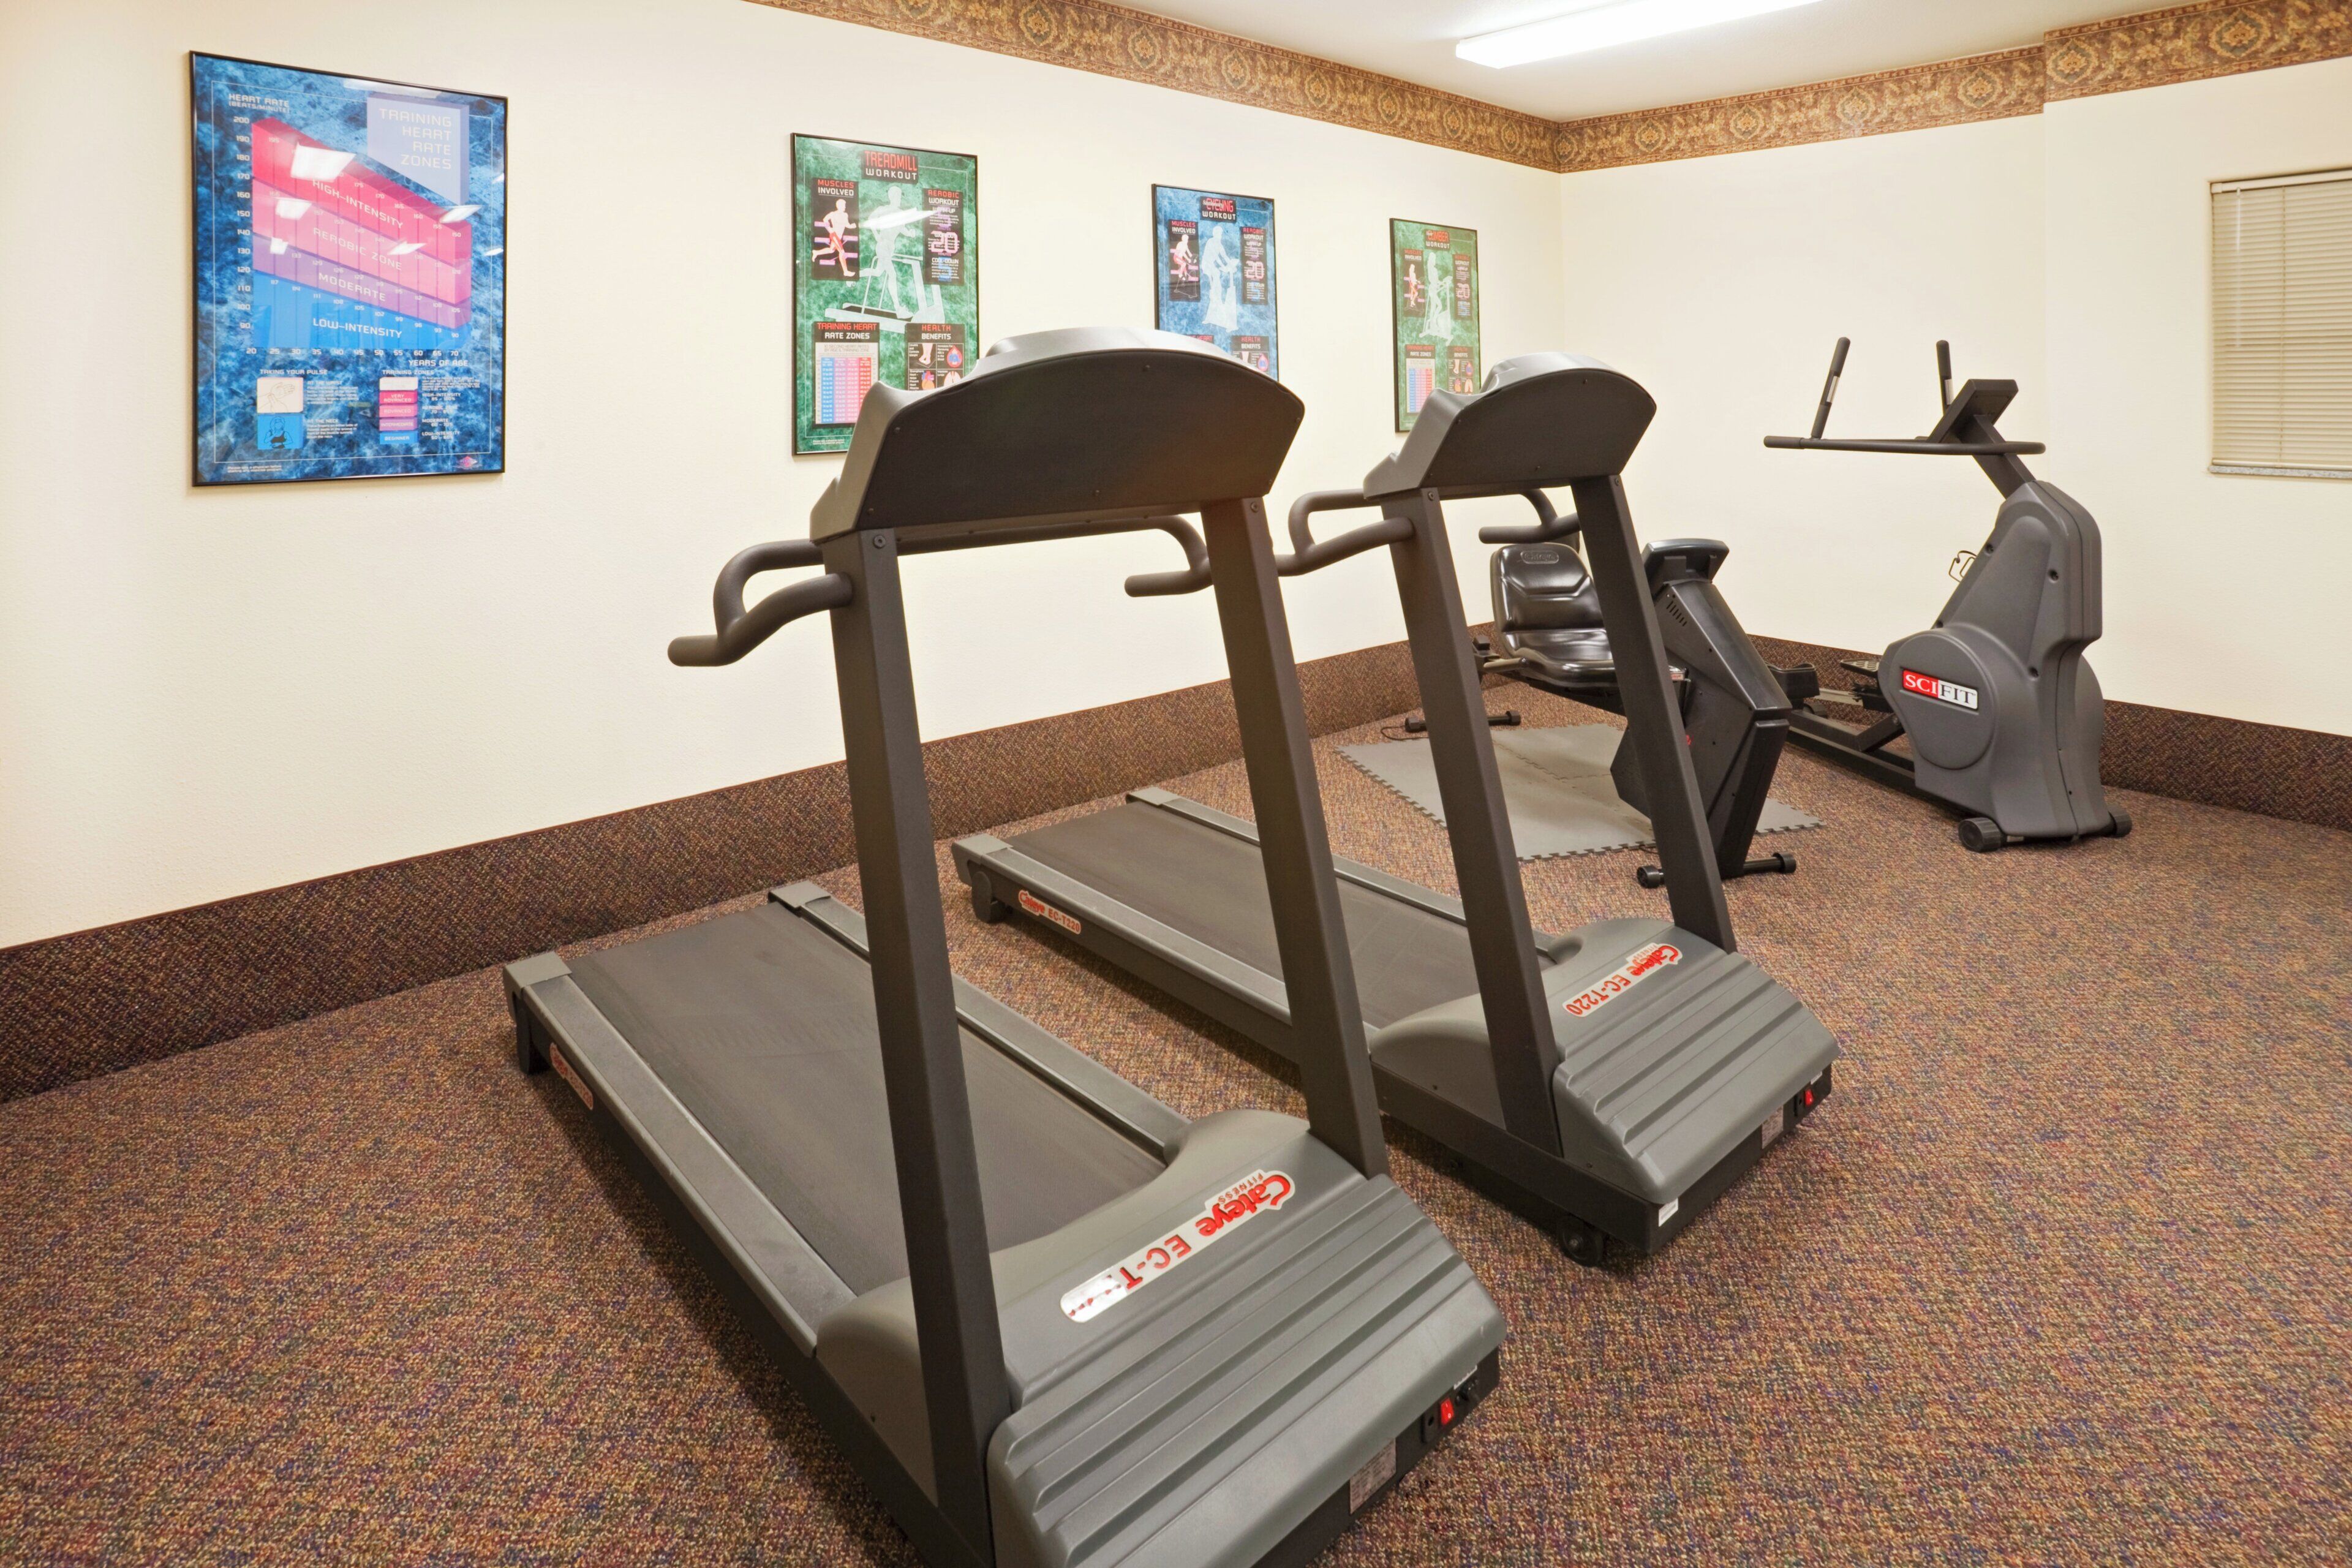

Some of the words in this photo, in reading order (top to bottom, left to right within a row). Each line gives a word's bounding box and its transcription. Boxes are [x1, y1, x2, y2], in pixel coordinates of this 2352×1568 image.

[228, 94, 261, 103] HEART
[265, 98, 289, 107] RATE
[379, 108, 451, 127] TRAINING
[402, 126, 451, 141] HEART
[413, 141, 451, 156] RATE
[401, 154, 451, 170] ZONES
[864, 150, 918, 171] TREADMILL
[865, 168, 917, 180] WORKOUT
[818, 179, 854, 189] MUSCLES
[818, 187, 854, 196] INVOLVED
[928, 190, 959, 198] AEROBIC
[929, 197, 959, 206] WORKOUT
[312, 179, 404, 229] HIGH-INTENSITY
[1202, 211, 1236, 220] WORKOUT
[313, 227, 367, 255] AEROBIC
[371, 252, 402, 271] ZONE
[931, 230, 958, 254] 20
[1246, 260, 1264, 279] 20
[318, 273, 386, 301] MODERATE
[313, 318, 402, 338] LOW-INTENSITY
[1049, 908, 1080, 932] EC-T220
[1626, 945, 1679, 976] Cateye
[1566, 974, 1631, 1015] EC-T220
[1218, 1172, 1264, 1204] FITNESS
[1195, 1174, 1291, 1237] Cateye
